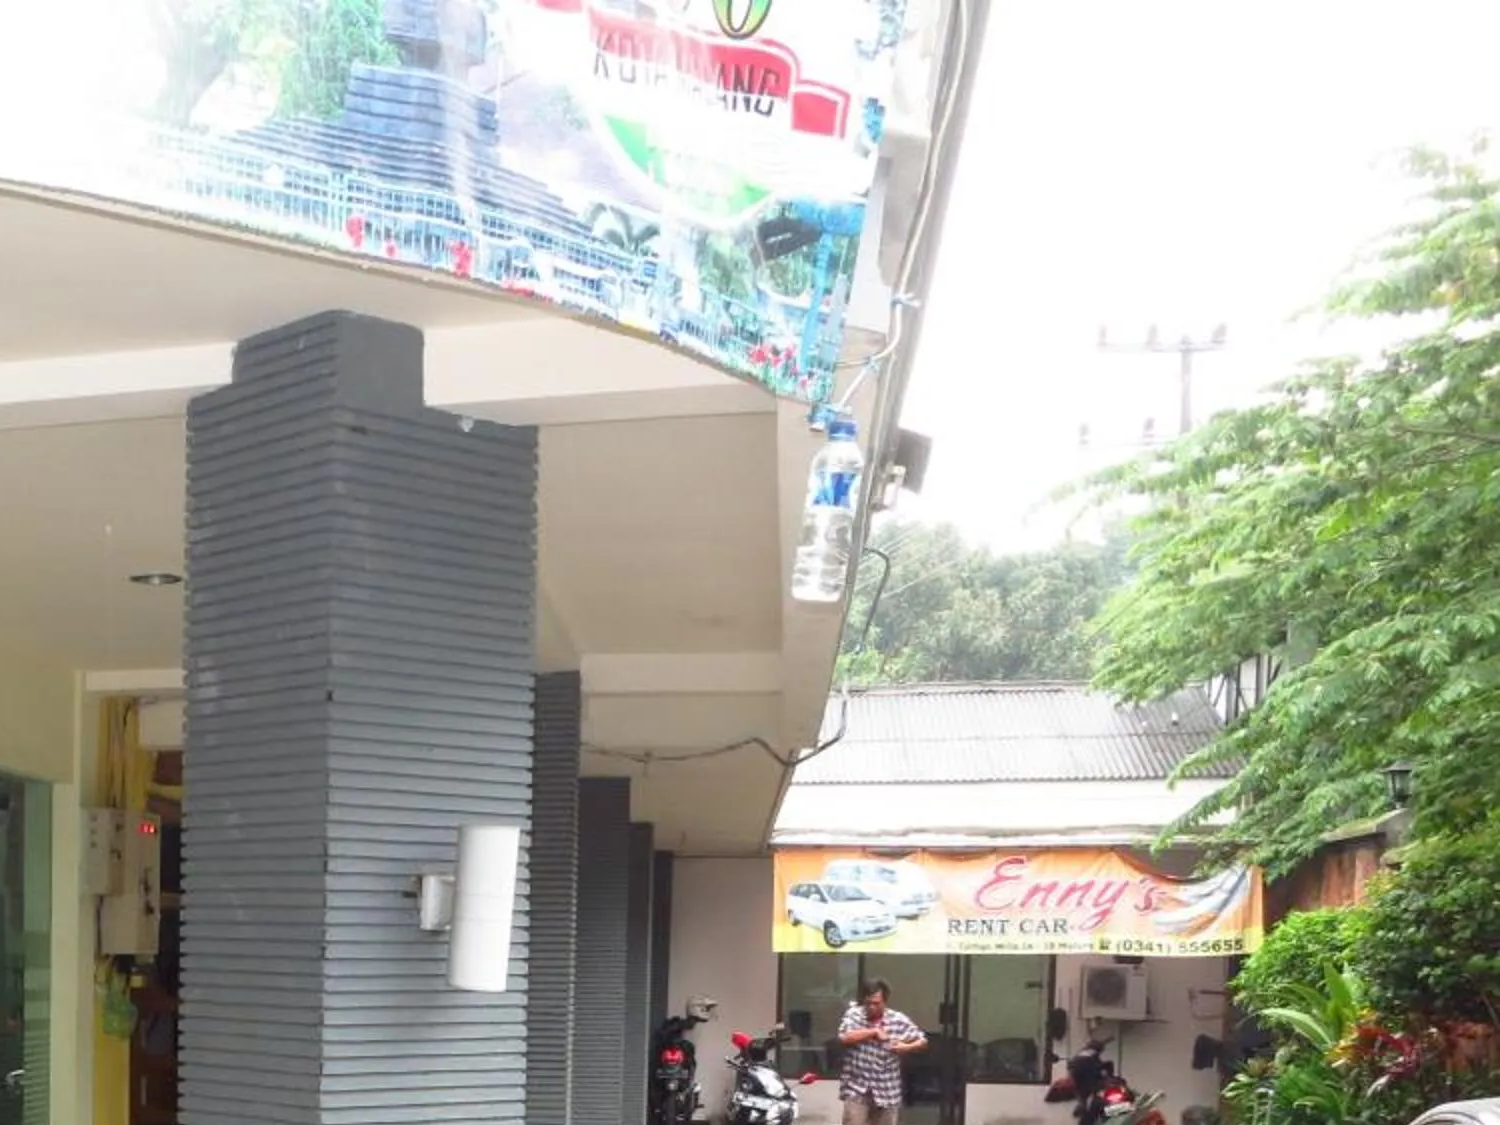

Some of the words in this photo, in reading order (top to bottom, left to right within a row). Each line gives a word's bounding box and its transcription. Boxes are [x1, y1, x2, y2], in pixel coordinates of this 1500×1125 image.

[973, 856, 1167, 931] Enny's
[947, 918, 1010, 935] RENT
[1019, 918, 1068, 935] CAR
